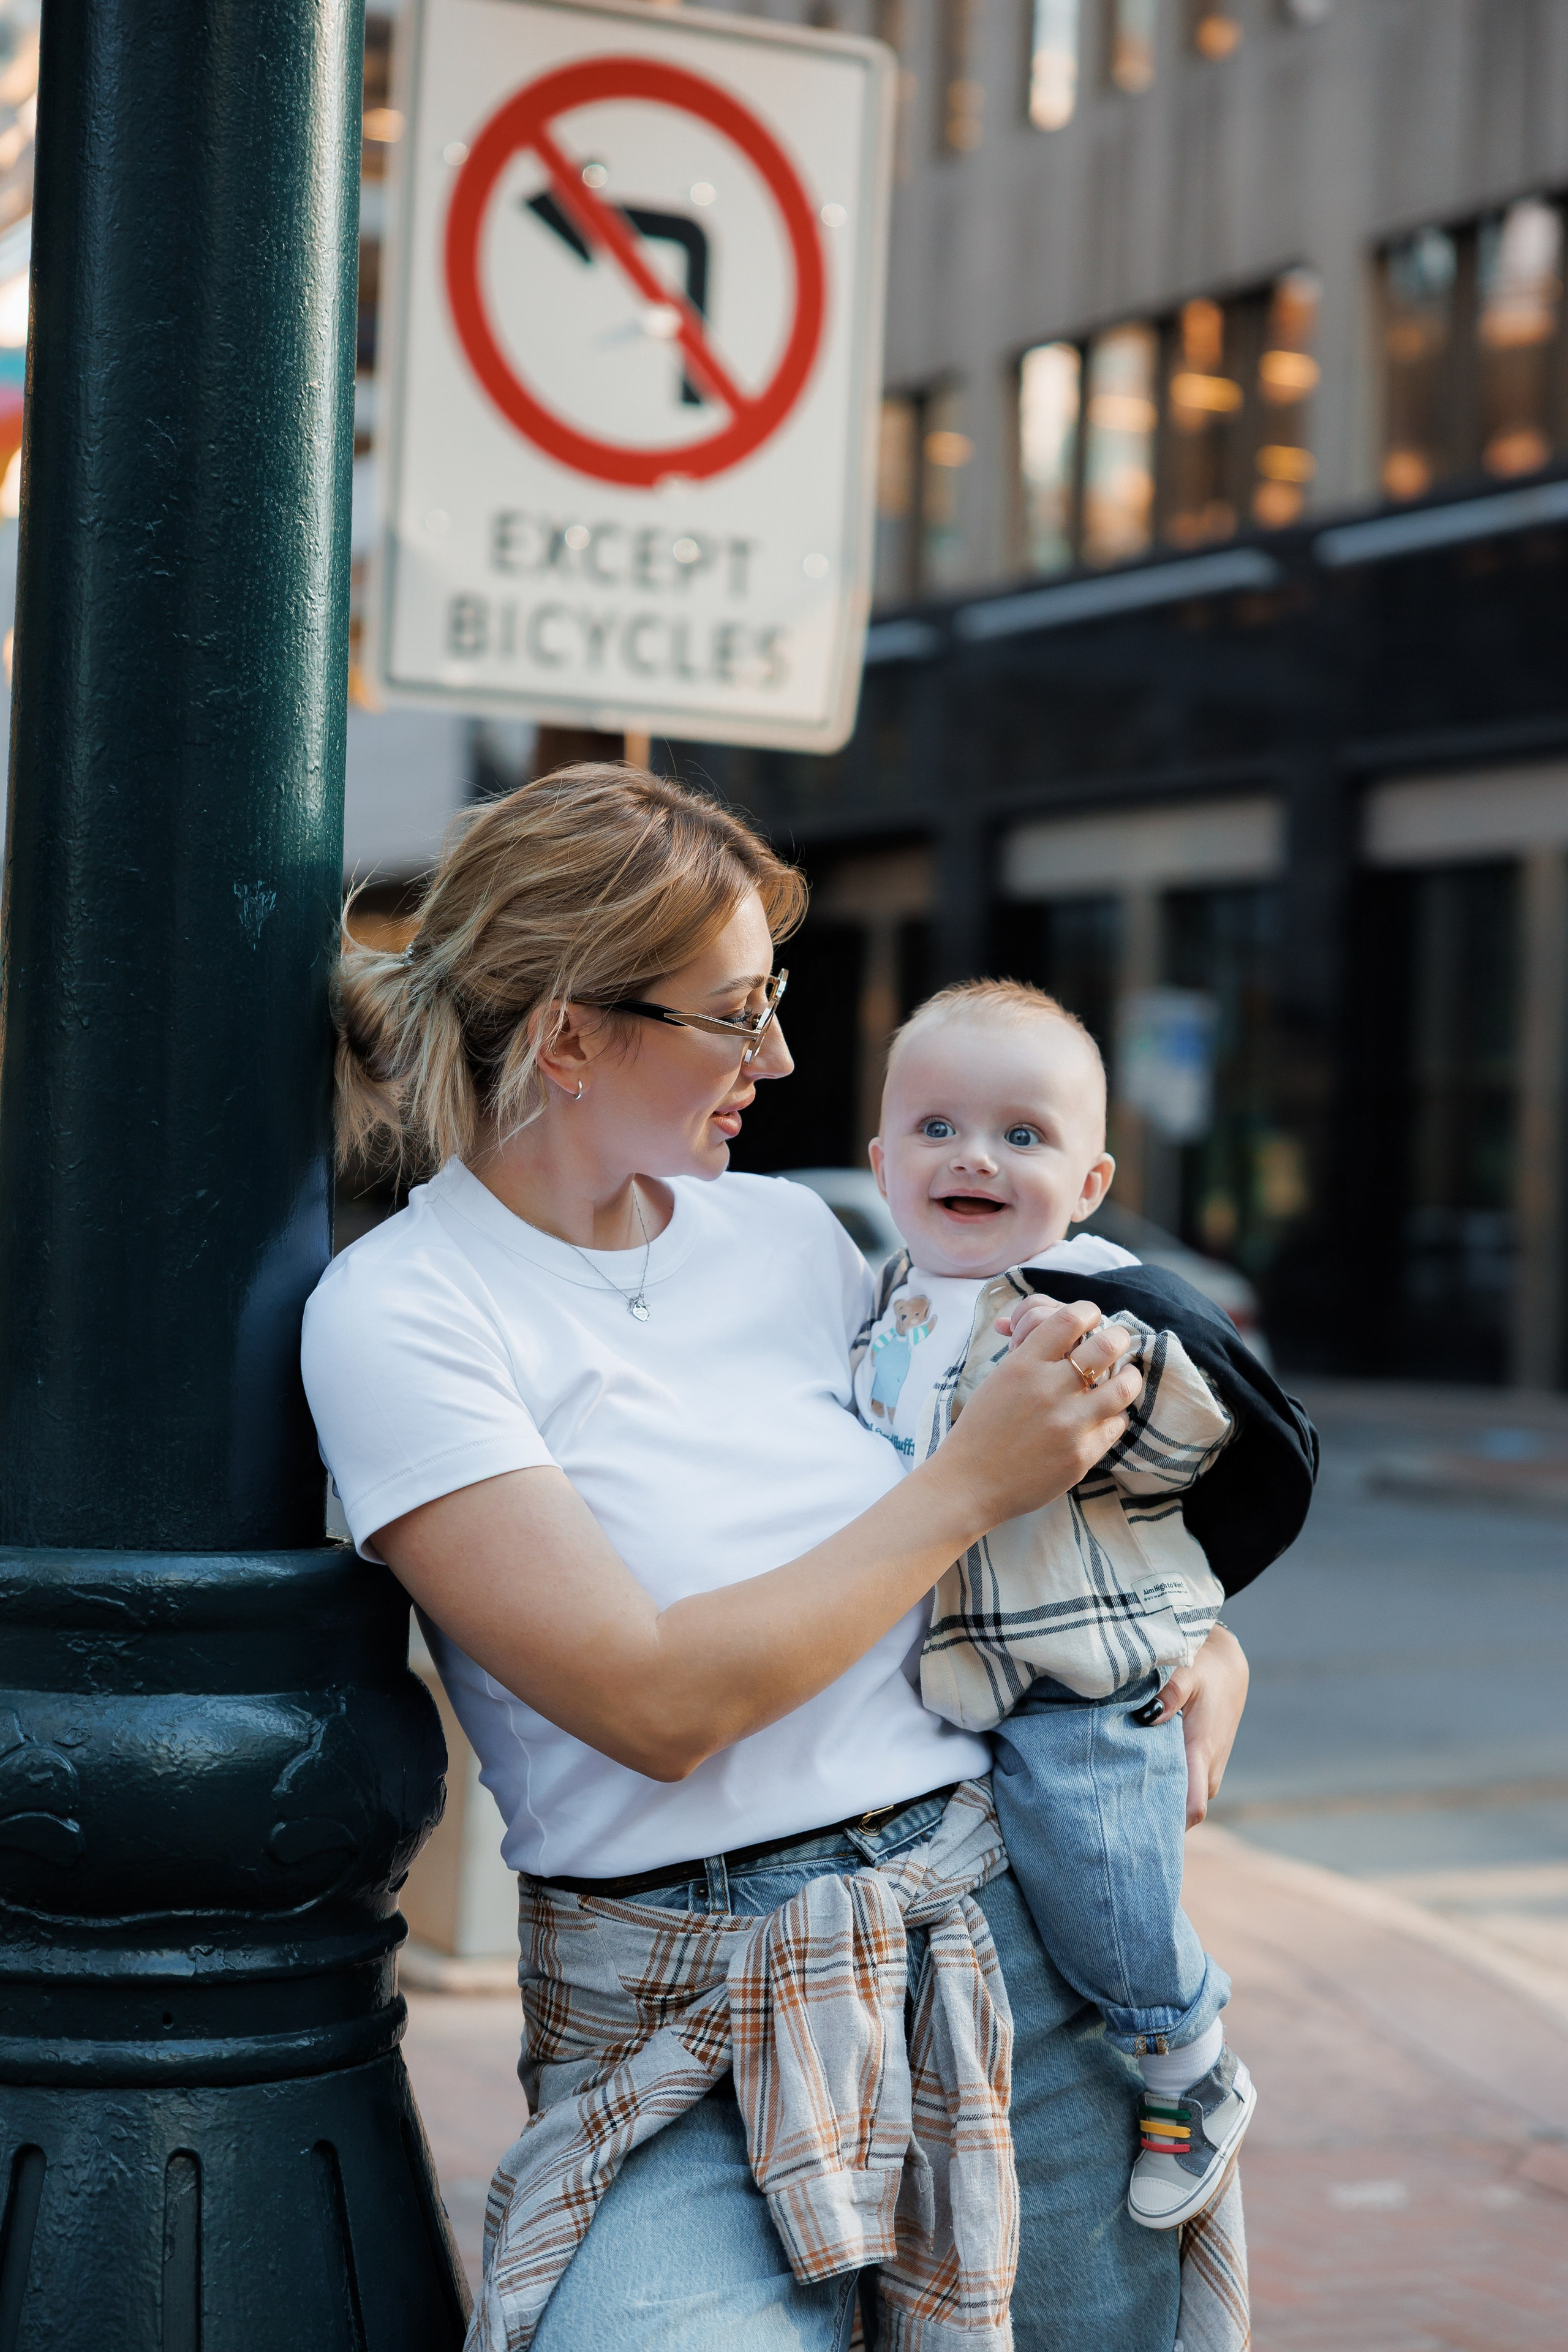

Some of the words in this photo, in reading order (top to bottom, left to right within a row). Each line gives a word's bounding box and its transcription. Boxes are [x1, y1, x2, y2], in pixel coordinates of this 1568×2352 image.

[493, 507, 758, 600] EXCEPT
[448, 594, 791, 688] BICYCLES
[698, 1019, 720, 1029] PRADA
[1154, 1583, 1167, 1592] High
